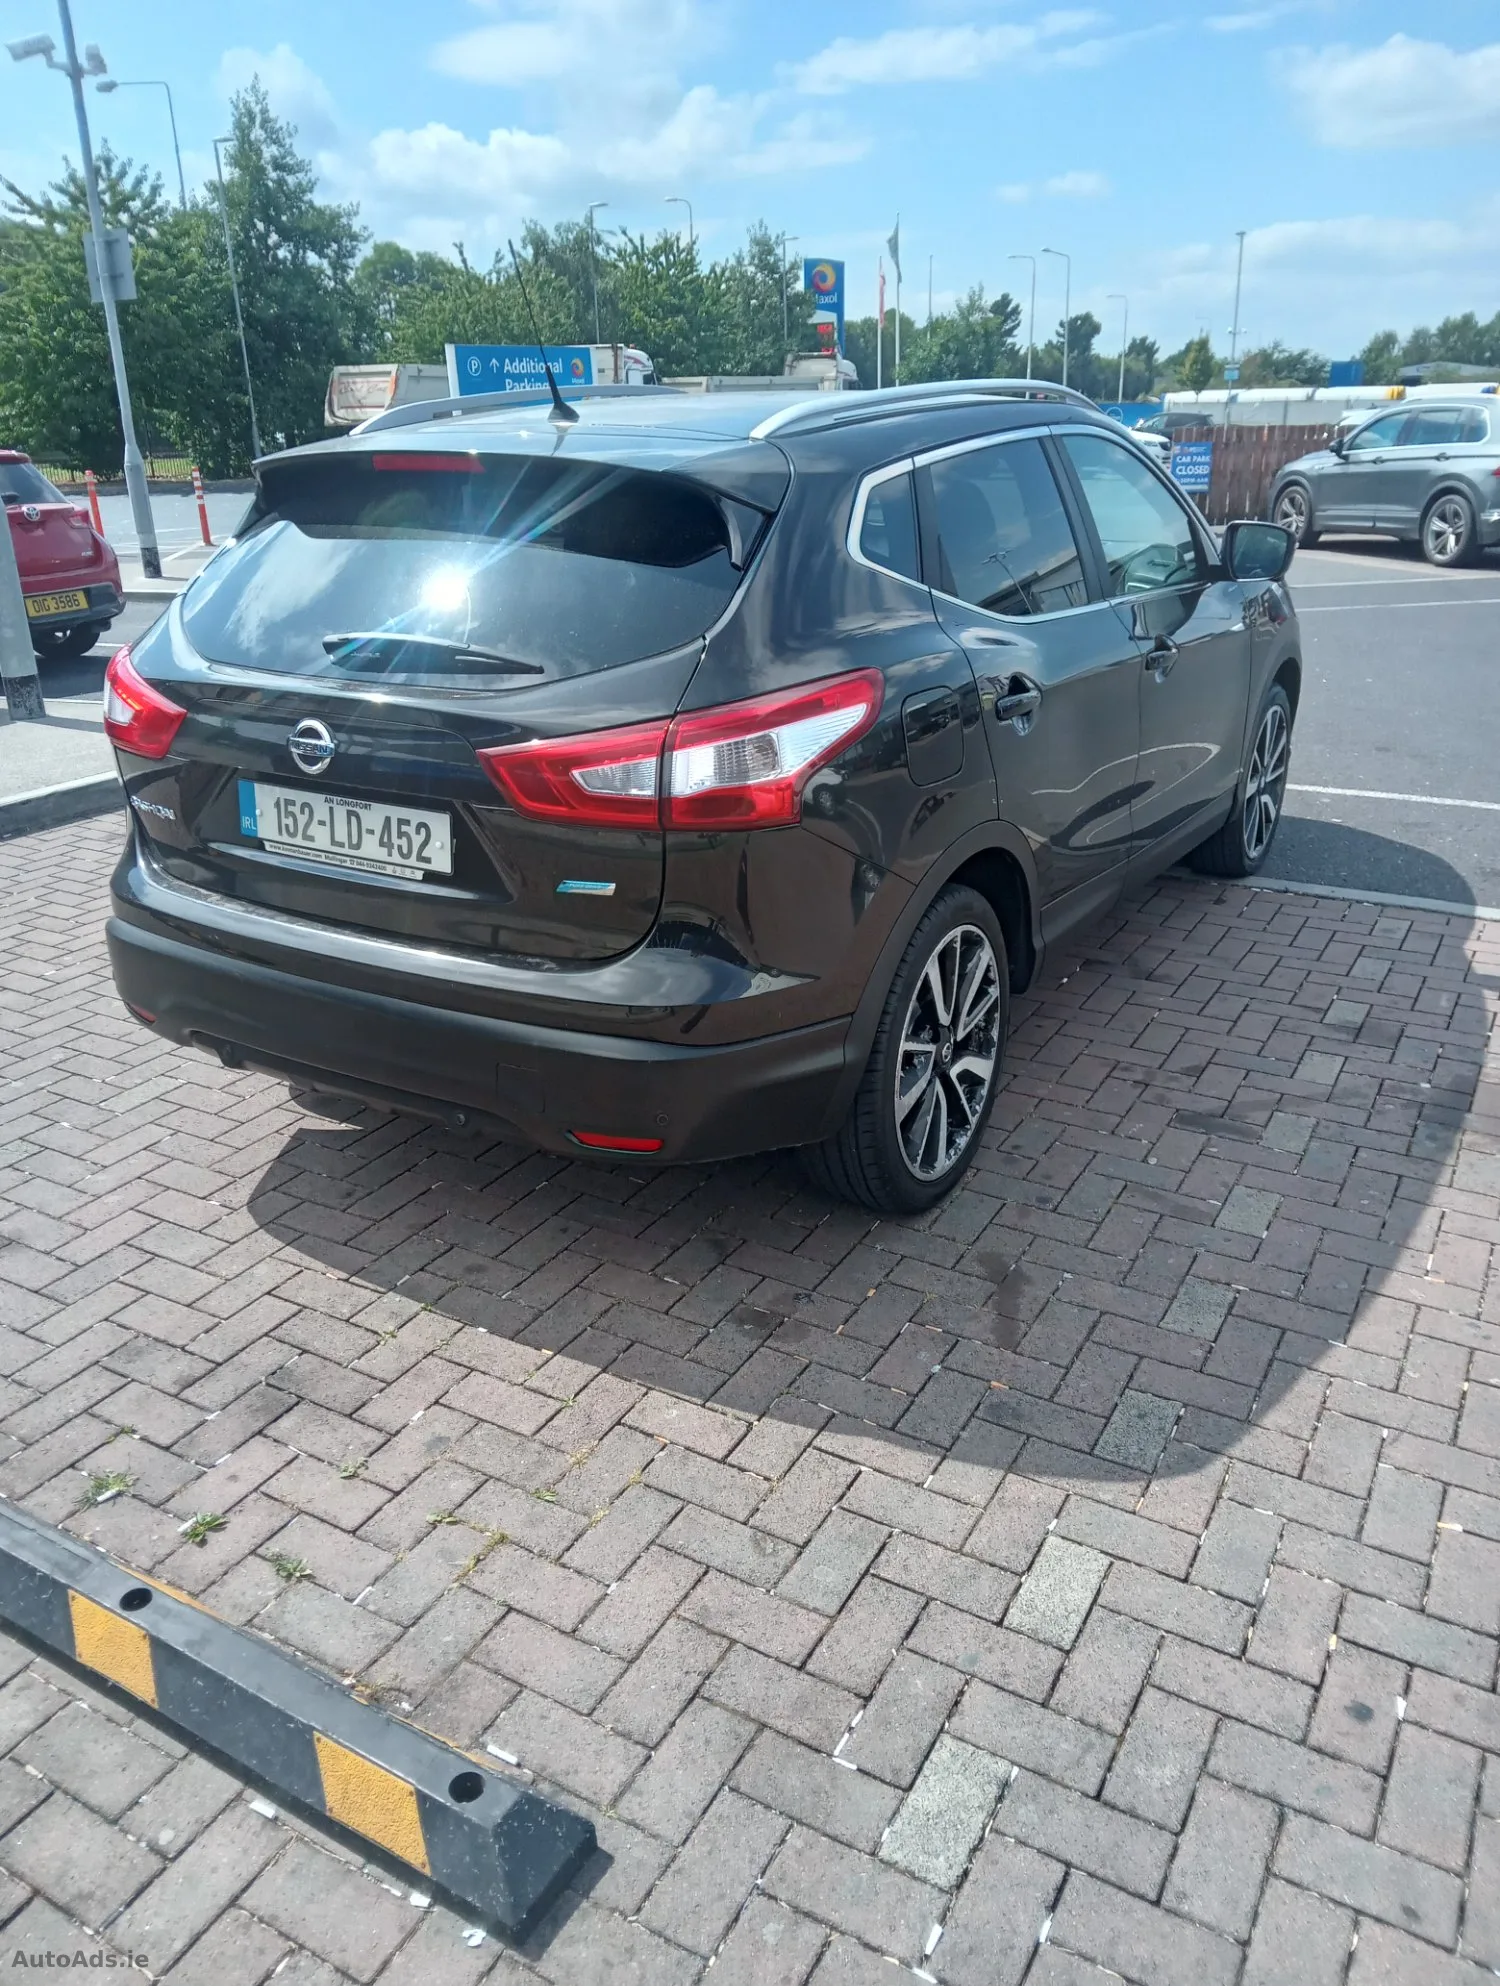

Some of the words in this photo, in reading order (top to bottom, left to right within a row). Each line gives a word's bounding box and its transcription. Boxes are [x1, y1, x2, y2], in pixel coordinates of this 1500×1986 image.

[1176, 455, 1191, 463] CAR
[1176, 465, 1210, 475] CLOSED
[32, 599, 51, 613] OIG
[51, 593, 80, 610] 3586
[292, 740, 328, 755] NISSAN
[324, 796, 335, 805] AN
[336, 798, 372, 811] LONGFORT
[242, 815, 257, 831] IRL
[273, 796, 433, 865] 152-LD-452
